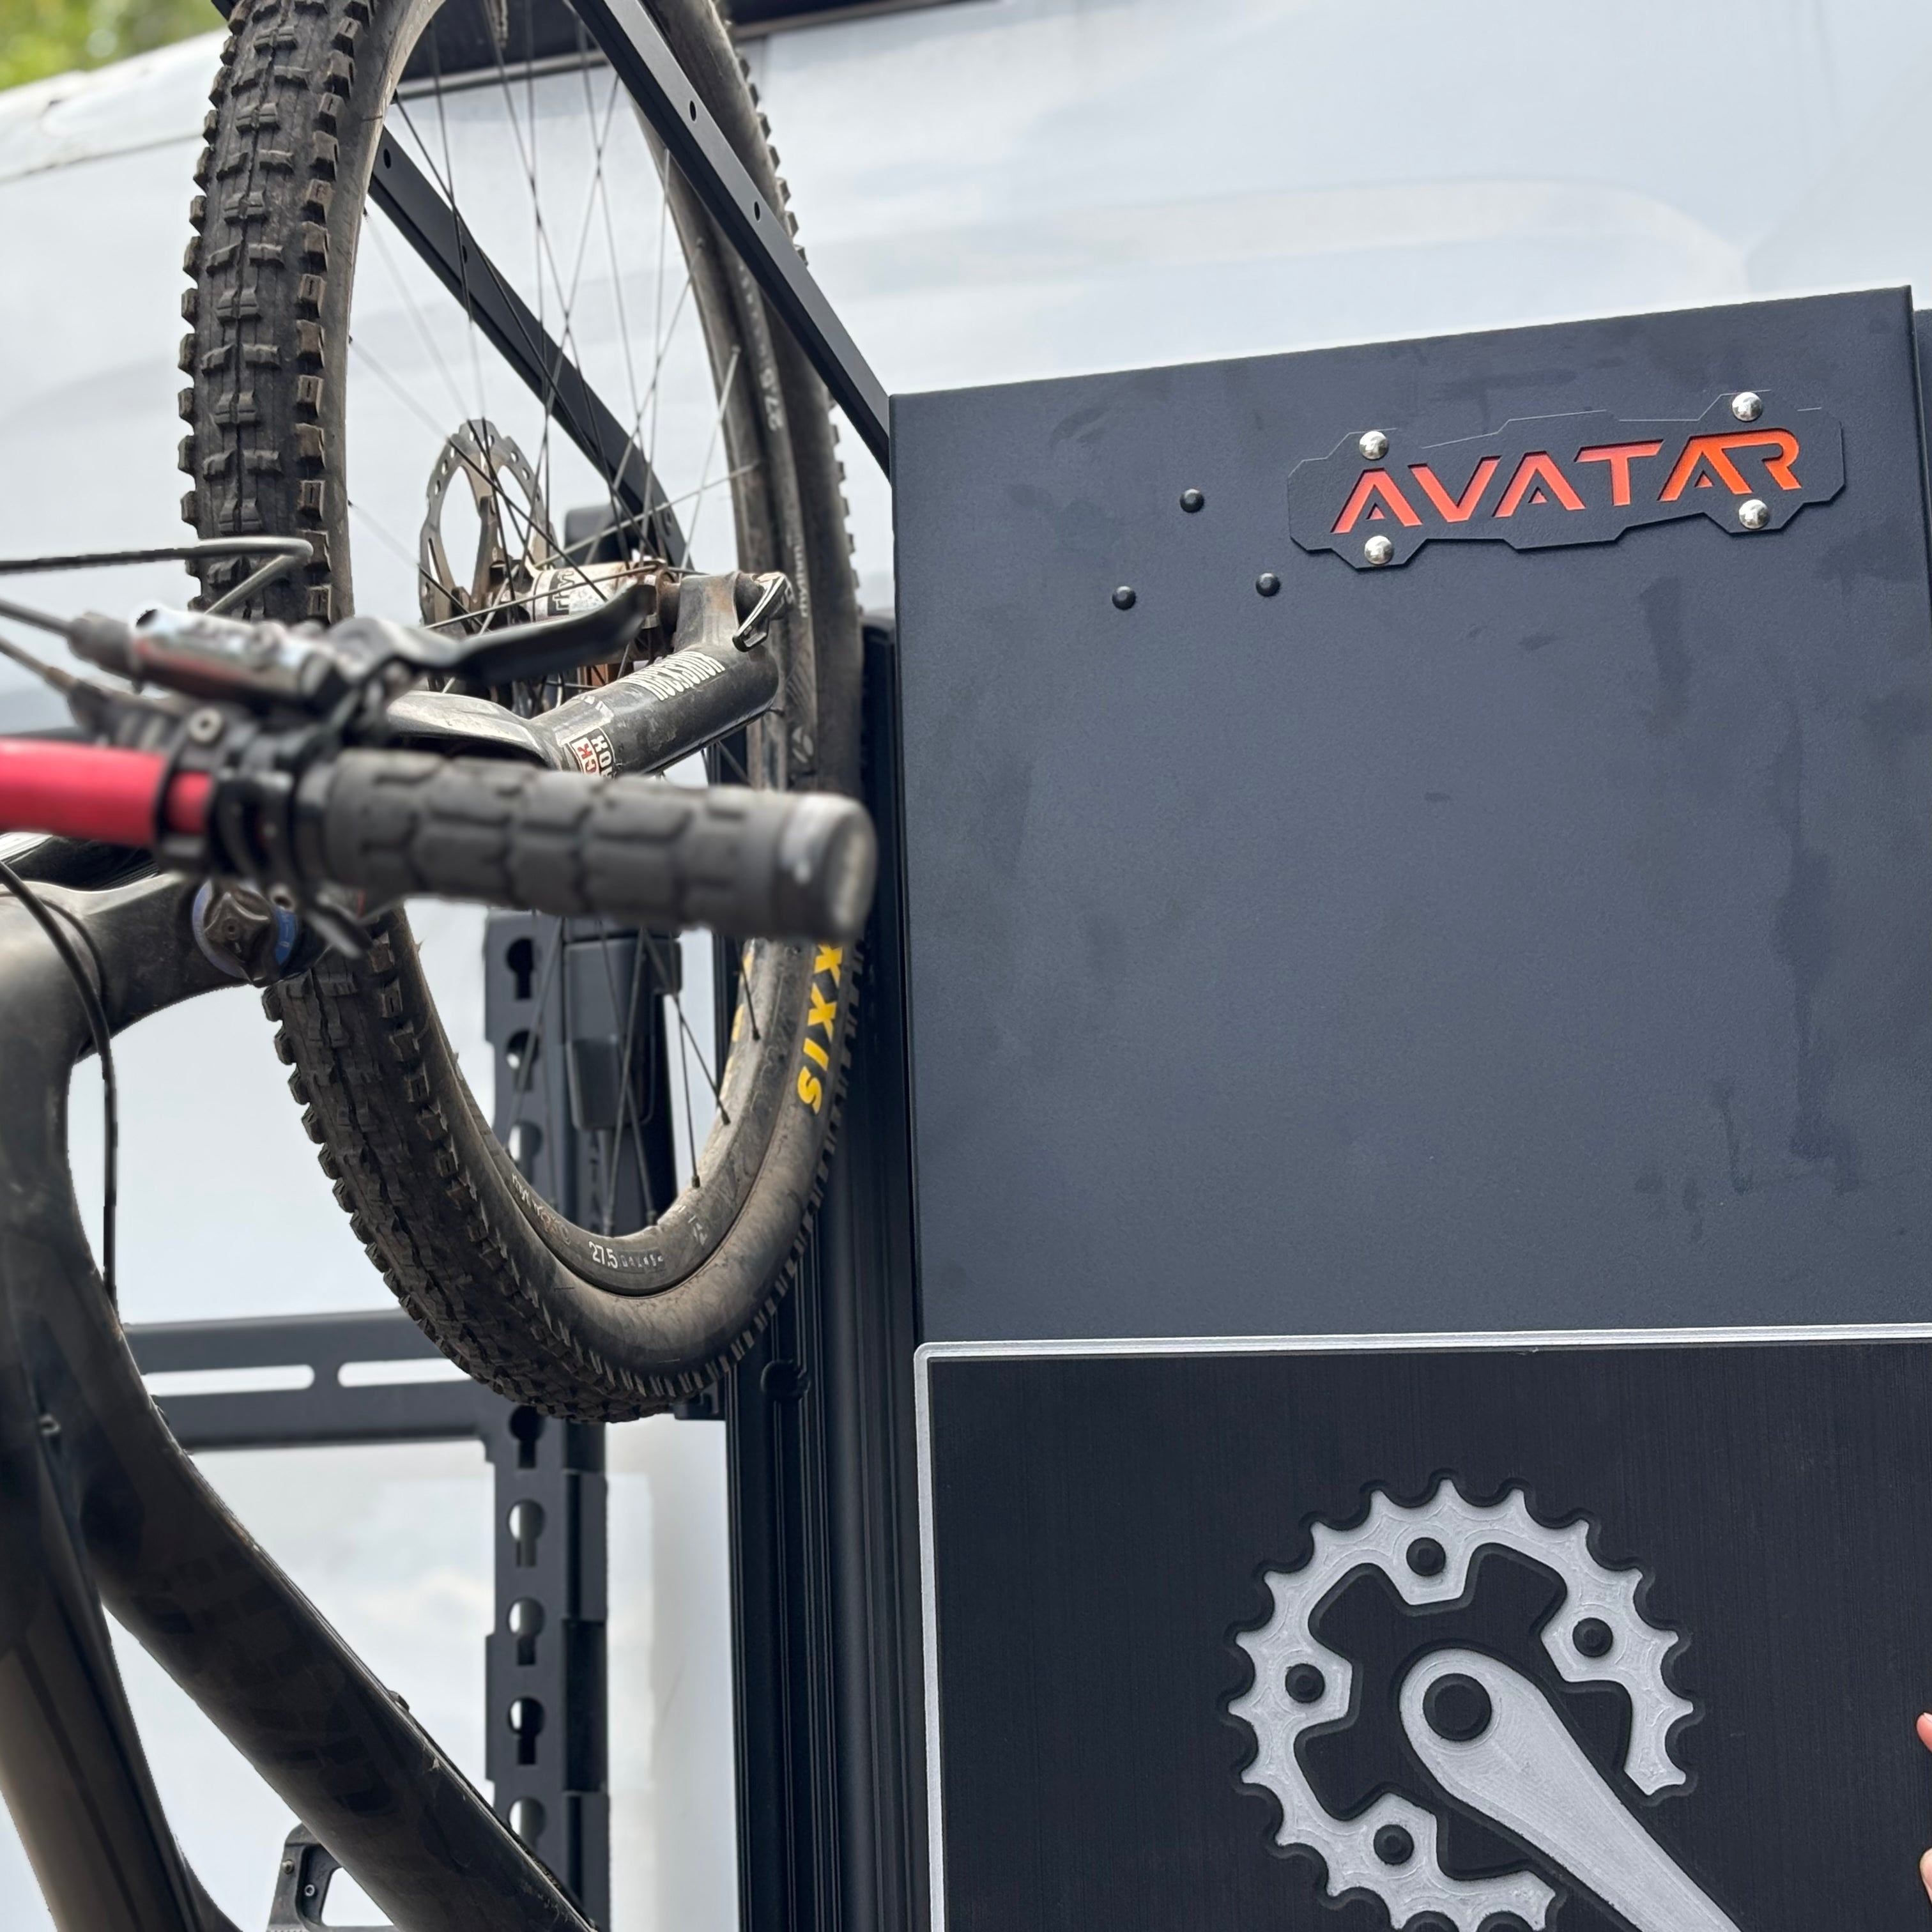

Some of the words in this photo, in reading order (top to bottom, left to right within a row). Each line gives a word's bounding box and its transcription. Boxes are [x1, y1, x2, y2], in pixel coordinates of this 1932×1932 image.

[1331, 427, 1801, 534] AVATAR
[577, 742, 597, 773] CK
[797, 944, 843, 1115] XXIS
[588, 1241, 618, 1269] 27.5
